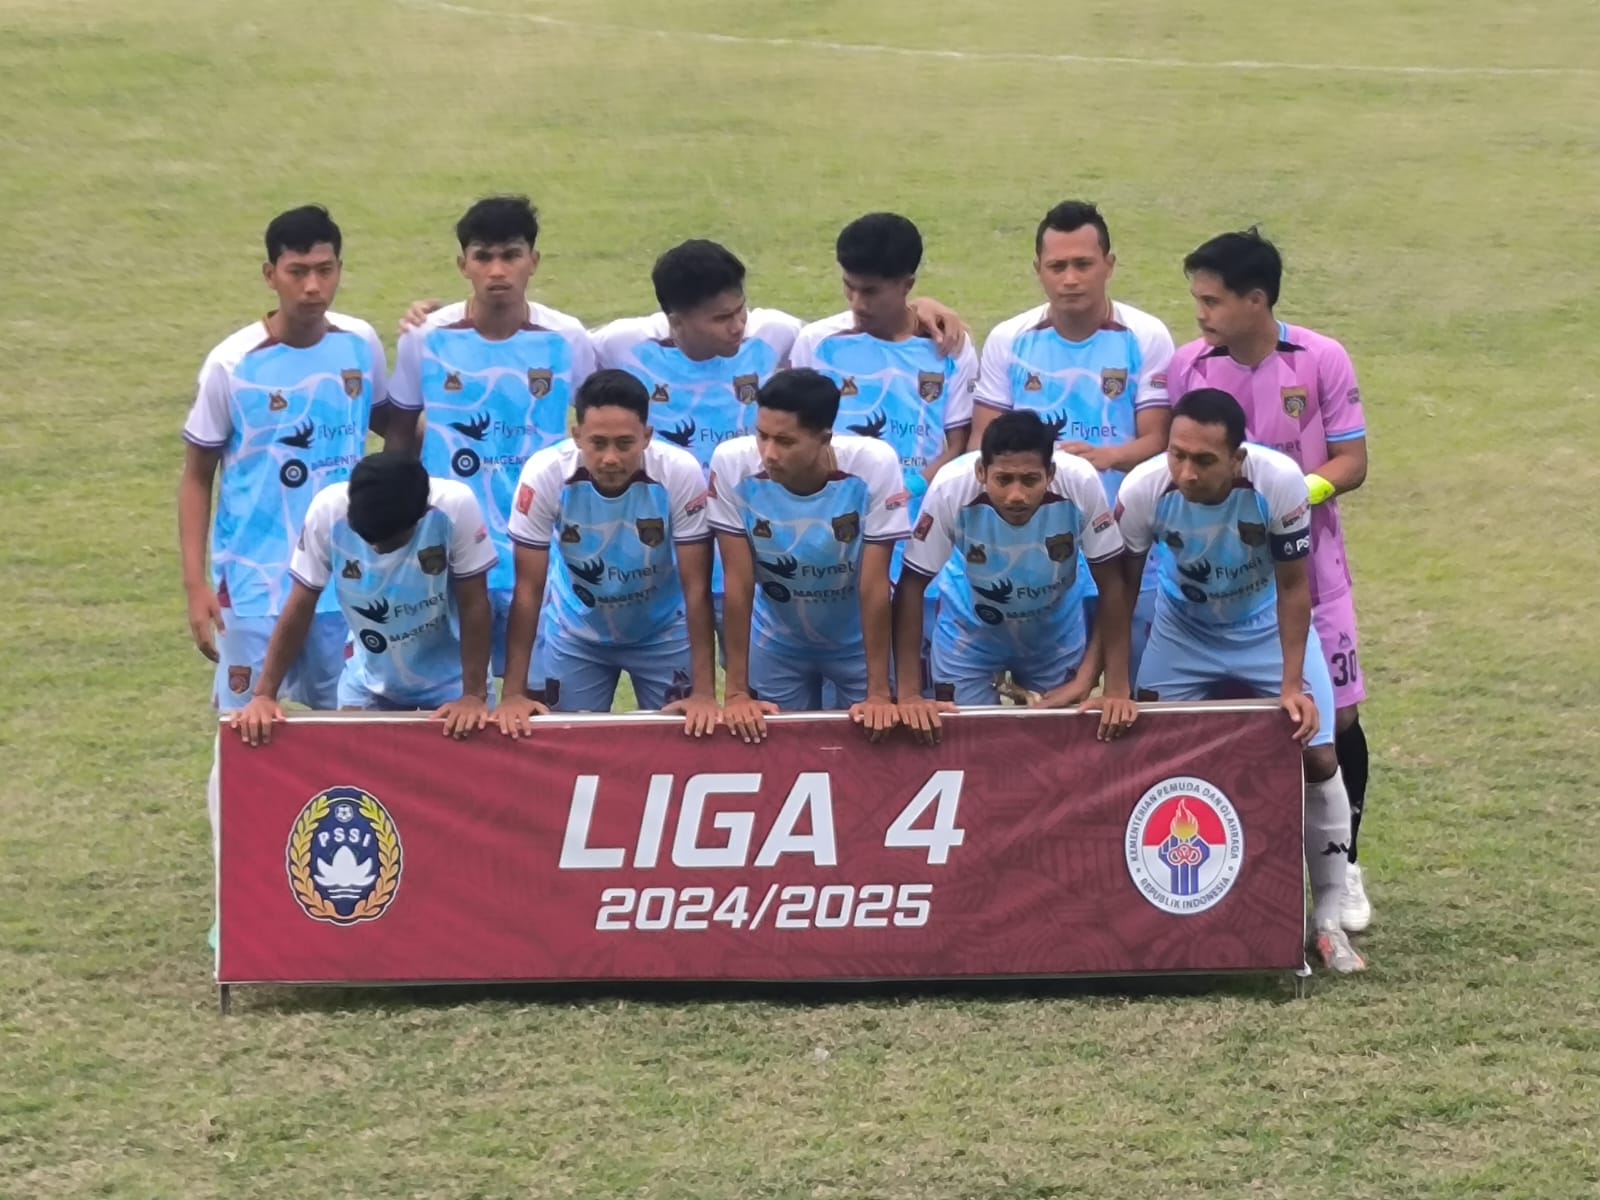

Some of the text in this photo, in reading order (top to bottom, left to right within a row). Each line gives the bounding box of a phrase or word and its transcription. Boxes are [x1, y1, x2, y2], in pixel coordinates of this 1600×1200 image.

[890, 419, 931, 438] Flynet
[1071, 421, 1118, 440] Flynet
[608, 564, 657, 584] Flynet
[801, 561, 854, 578] Flynet
[394, 592, 445, 618] Flynet
[1331, 649, 1357, 687] 30
[558, 769, 965, 869] LIGA 4
[1129, 782, 1240, 862] KEMENTERIAN PEMUDA DAN OLAHRAGA
[317, 827, 371, 848] PSSI
[1140, 876, 1230, 910] REPUBLIK INDONESIA
[595, 883, 933, 931] 2024/2025
